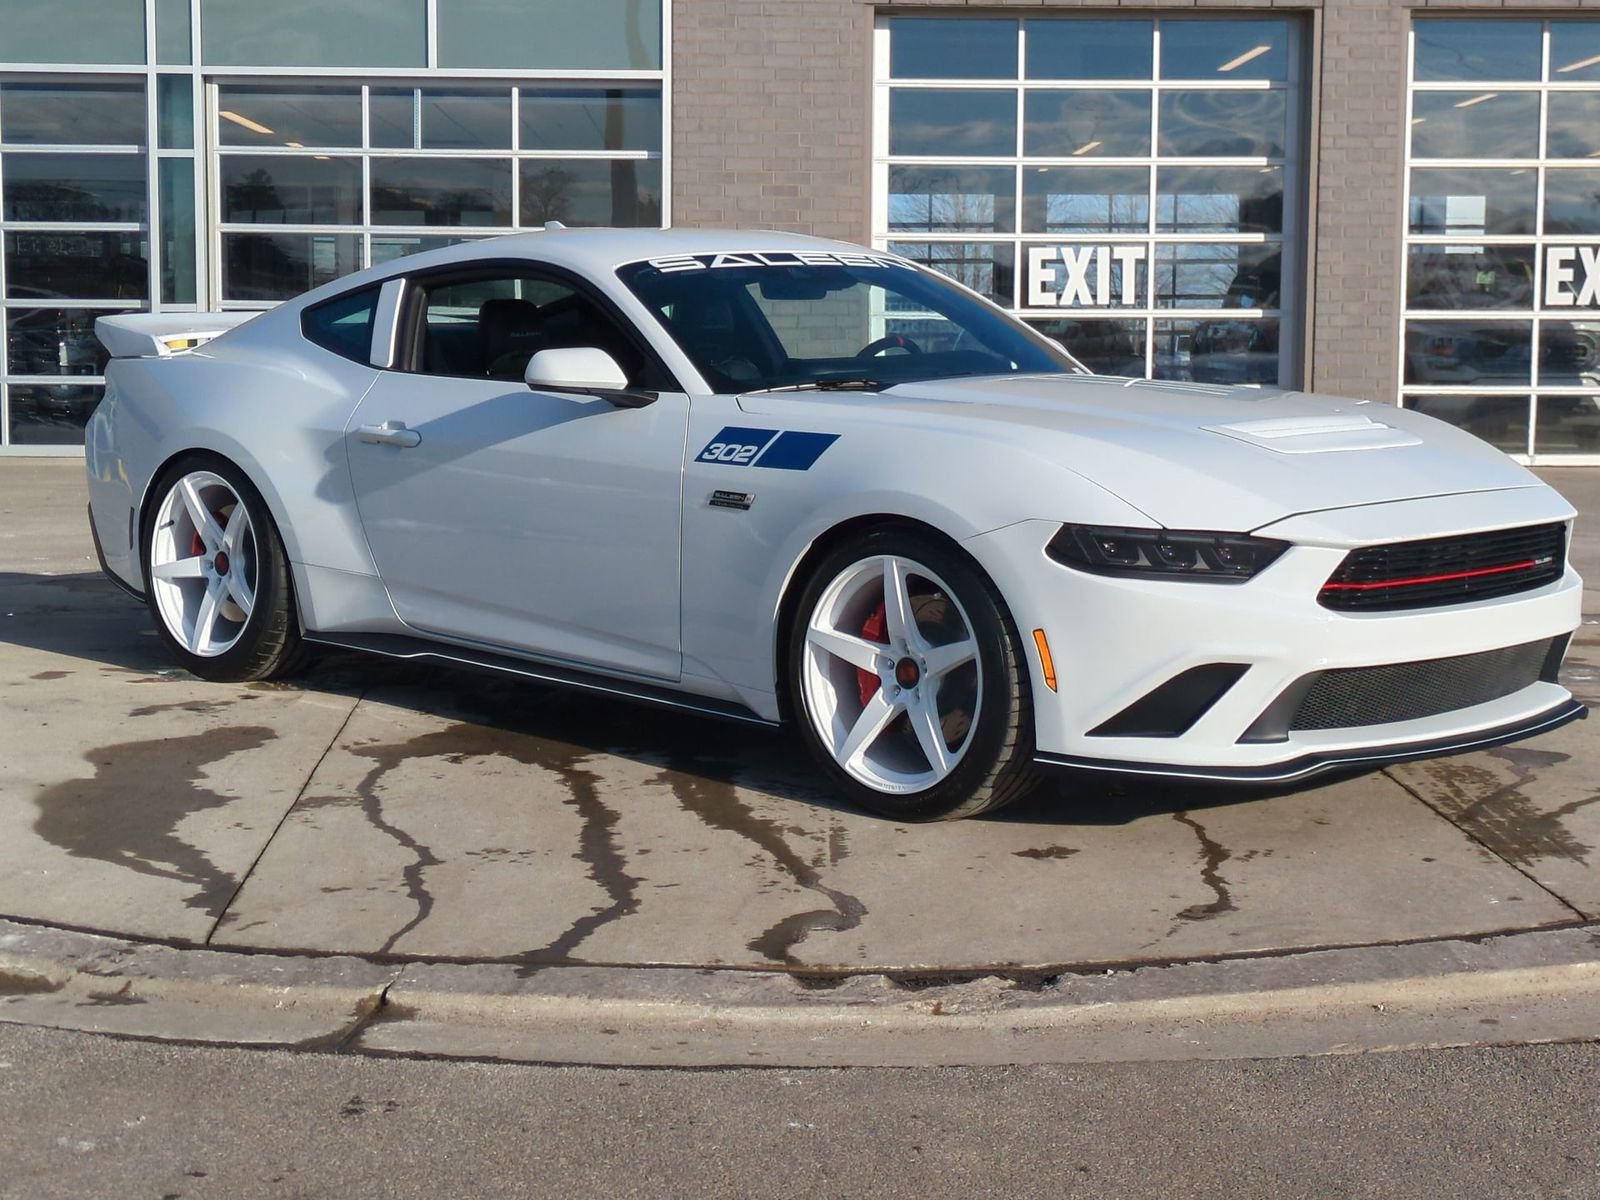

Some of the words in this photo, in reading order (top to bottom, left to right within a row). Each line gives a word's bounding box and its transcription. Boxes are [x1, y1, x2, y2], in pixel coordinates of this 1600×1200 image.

[648, 252, 918, 273] SALEEN
[1028, 247, 1146, 306] EXIT
[1545, 247, 1600, 306] EX
[703, 443, 758, 462] 302
